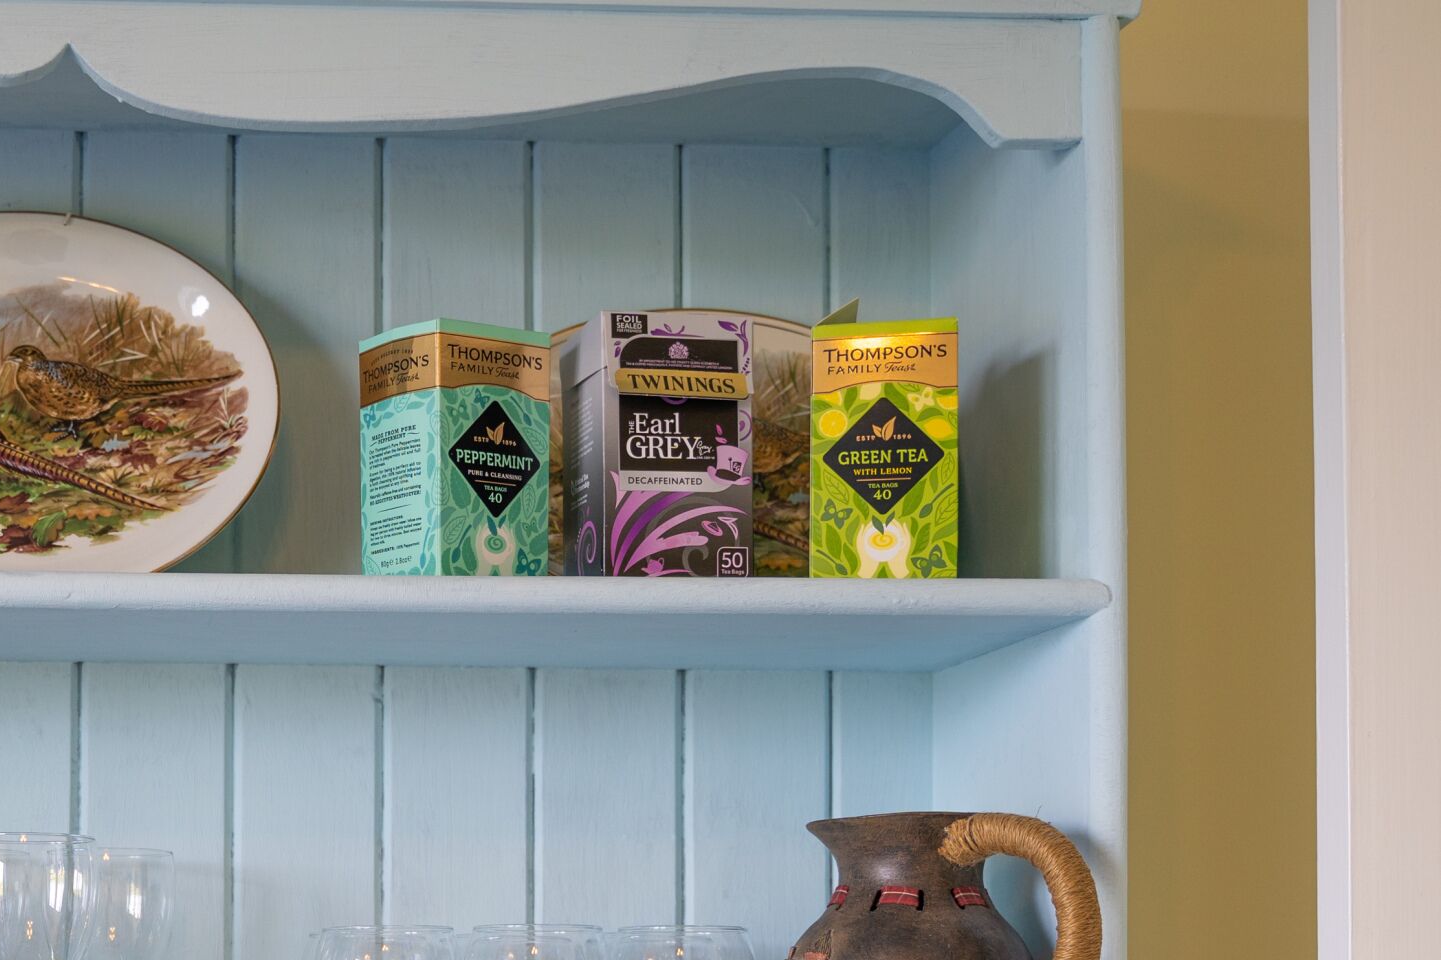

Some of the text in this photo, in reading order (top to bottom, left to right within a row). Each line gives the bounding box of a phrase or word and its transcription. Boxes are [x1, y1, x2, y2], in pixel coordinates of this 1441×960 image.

[616, 315, 641, 323] FOIL
[616, 322, 642, 330] SEALED
[448, 343, 543, 370] THOMPSON'S
[823, 344, 948, 363] THOMPSON'S
[362, 354, 429, 384] THOMPSON'S
[450, 361, 494, 376] FAMILY
[827, 363, 882, 375] FAMILY
[368, 377, 396, 393] FAMILY
[627, 373, 736, 394] TWININGS
[633, 412, 682, 434] Earl
[625, 435, 702, 460] GREY
[455, 448, 534, 471] PEPPERMINT
[838, 447, 929, 465] GREEN TEA
[467, 469, 484, 477] PURE
[490, 471, 523, 481] CLEANSING
[880, 466, 913, 475] LEMON
[627, 476, 703, 485] DECAFFEINATED
[488, 491, 503, 503] 40
[873, 488, 892, 500] 40
[721, 552, 743, 568] 50
[731, 568, 745, 576] Bags
